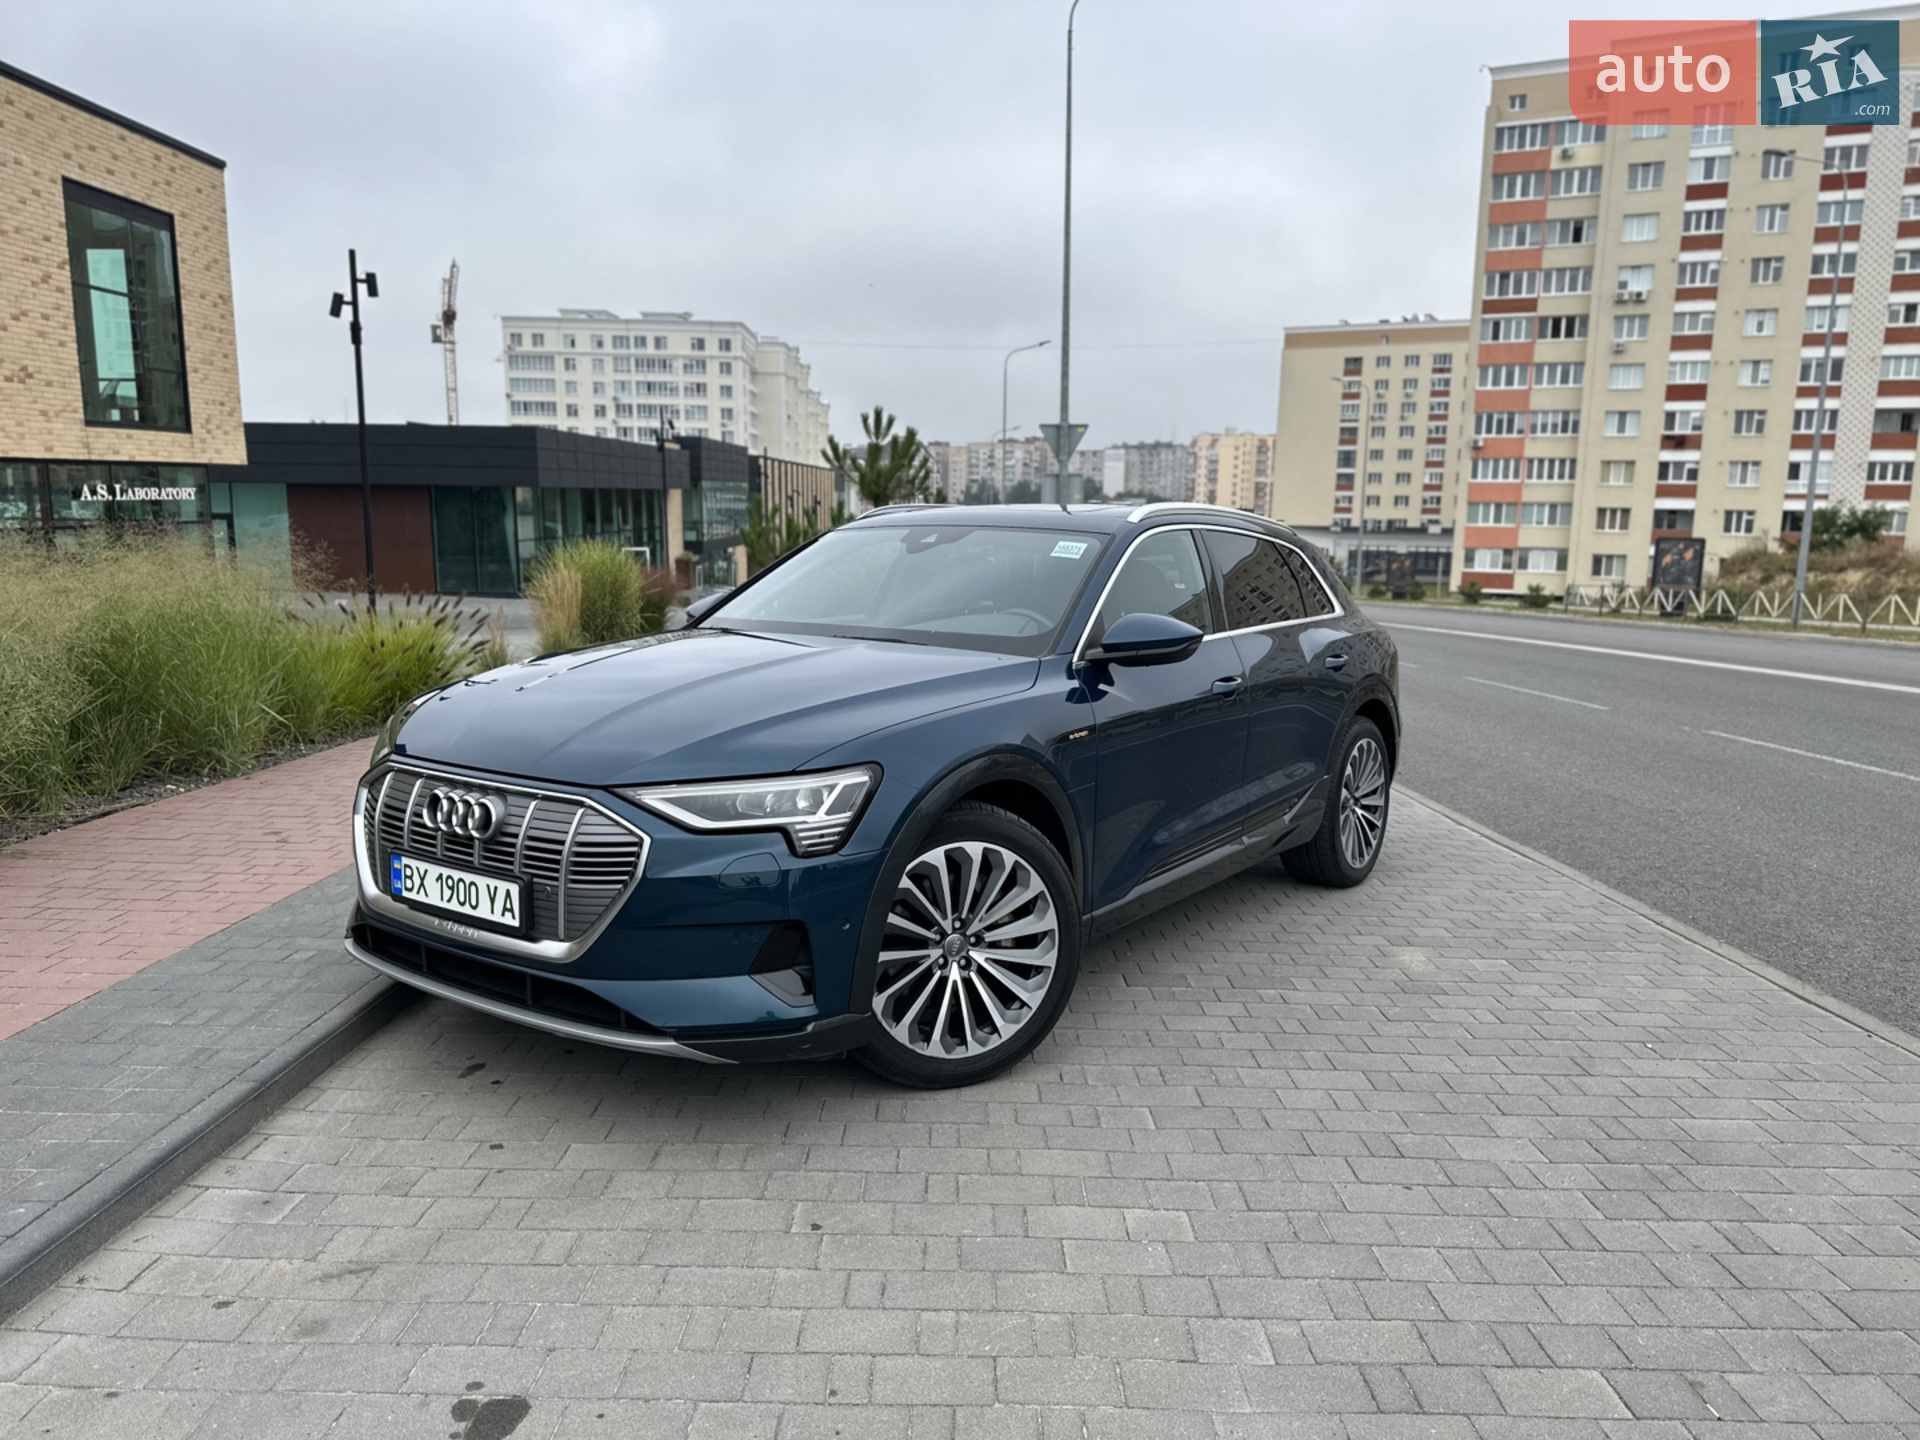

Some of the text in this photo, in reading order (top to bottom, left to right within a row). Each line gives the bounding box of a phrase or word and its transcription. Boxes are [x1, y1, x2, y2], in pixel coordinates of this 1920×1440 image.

[80, 484, 113, 500] A.S.
[403, 863, 516, 920] BX 1900 YA
